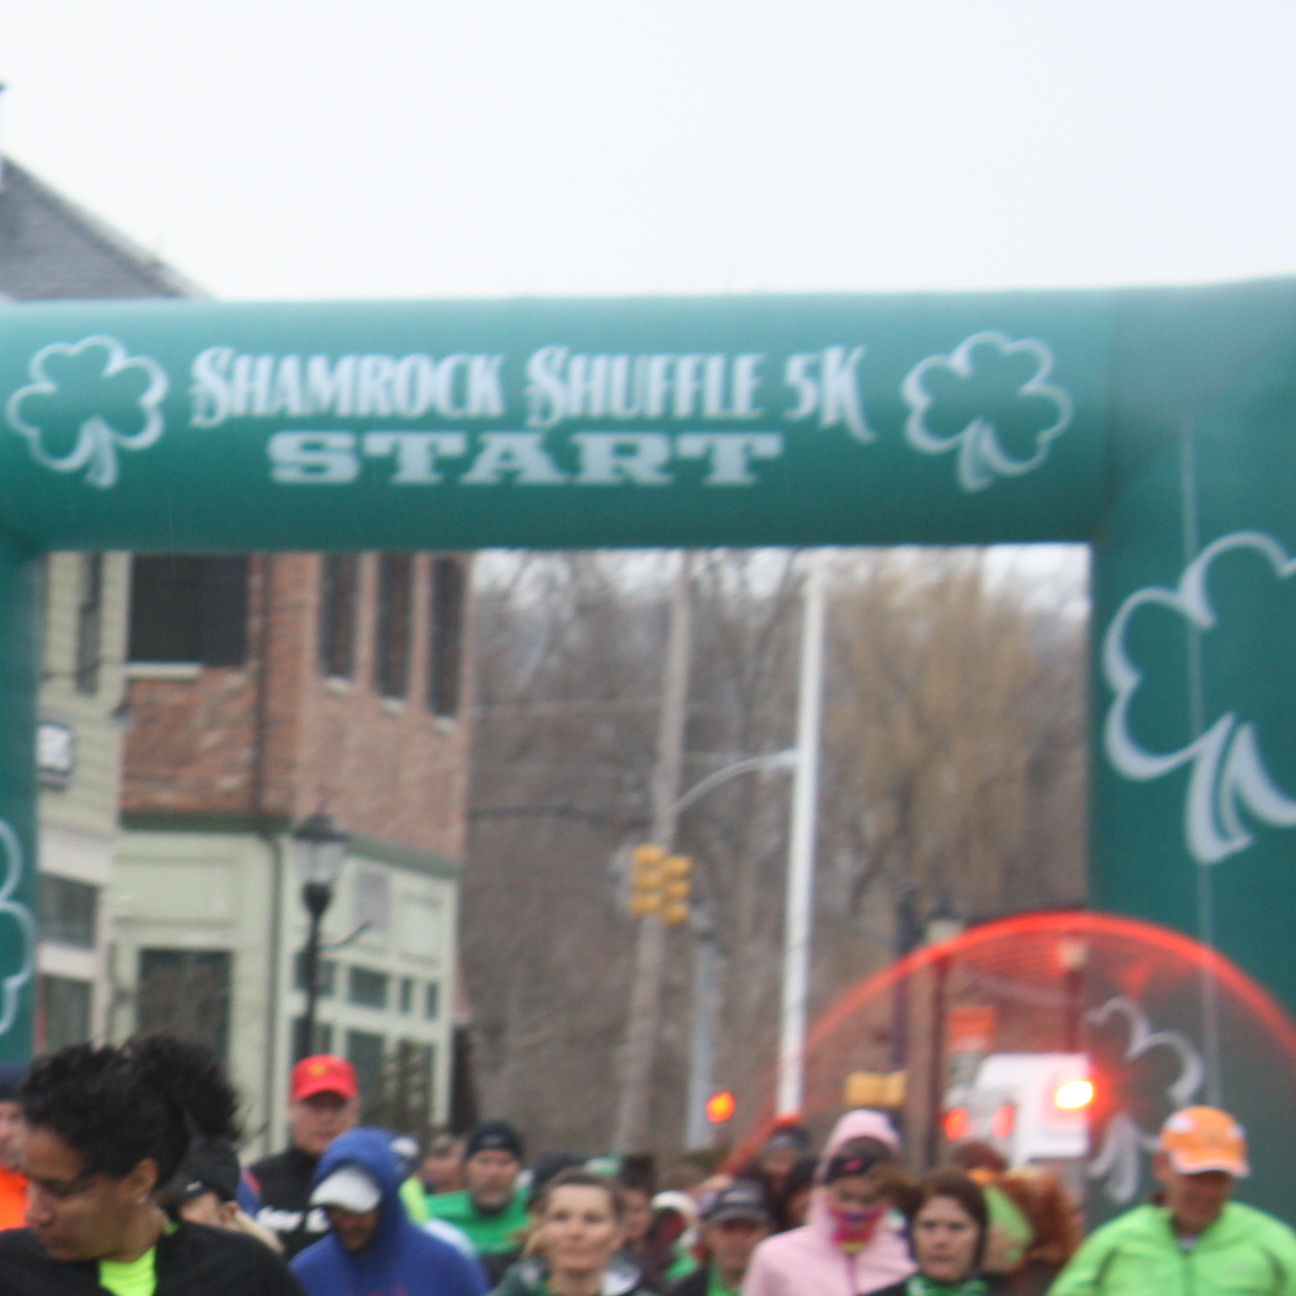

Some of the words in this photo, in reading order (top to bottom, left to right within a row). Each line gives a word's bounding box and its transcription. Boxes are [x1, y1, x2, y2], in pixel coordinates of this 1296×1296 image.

[189, 346, 506, 428] SHAMROCK
[523, 346, 766, 428] SHUFFLE
[783, 345, 876, 444] 5K
[266, 429, 784, 486] START
